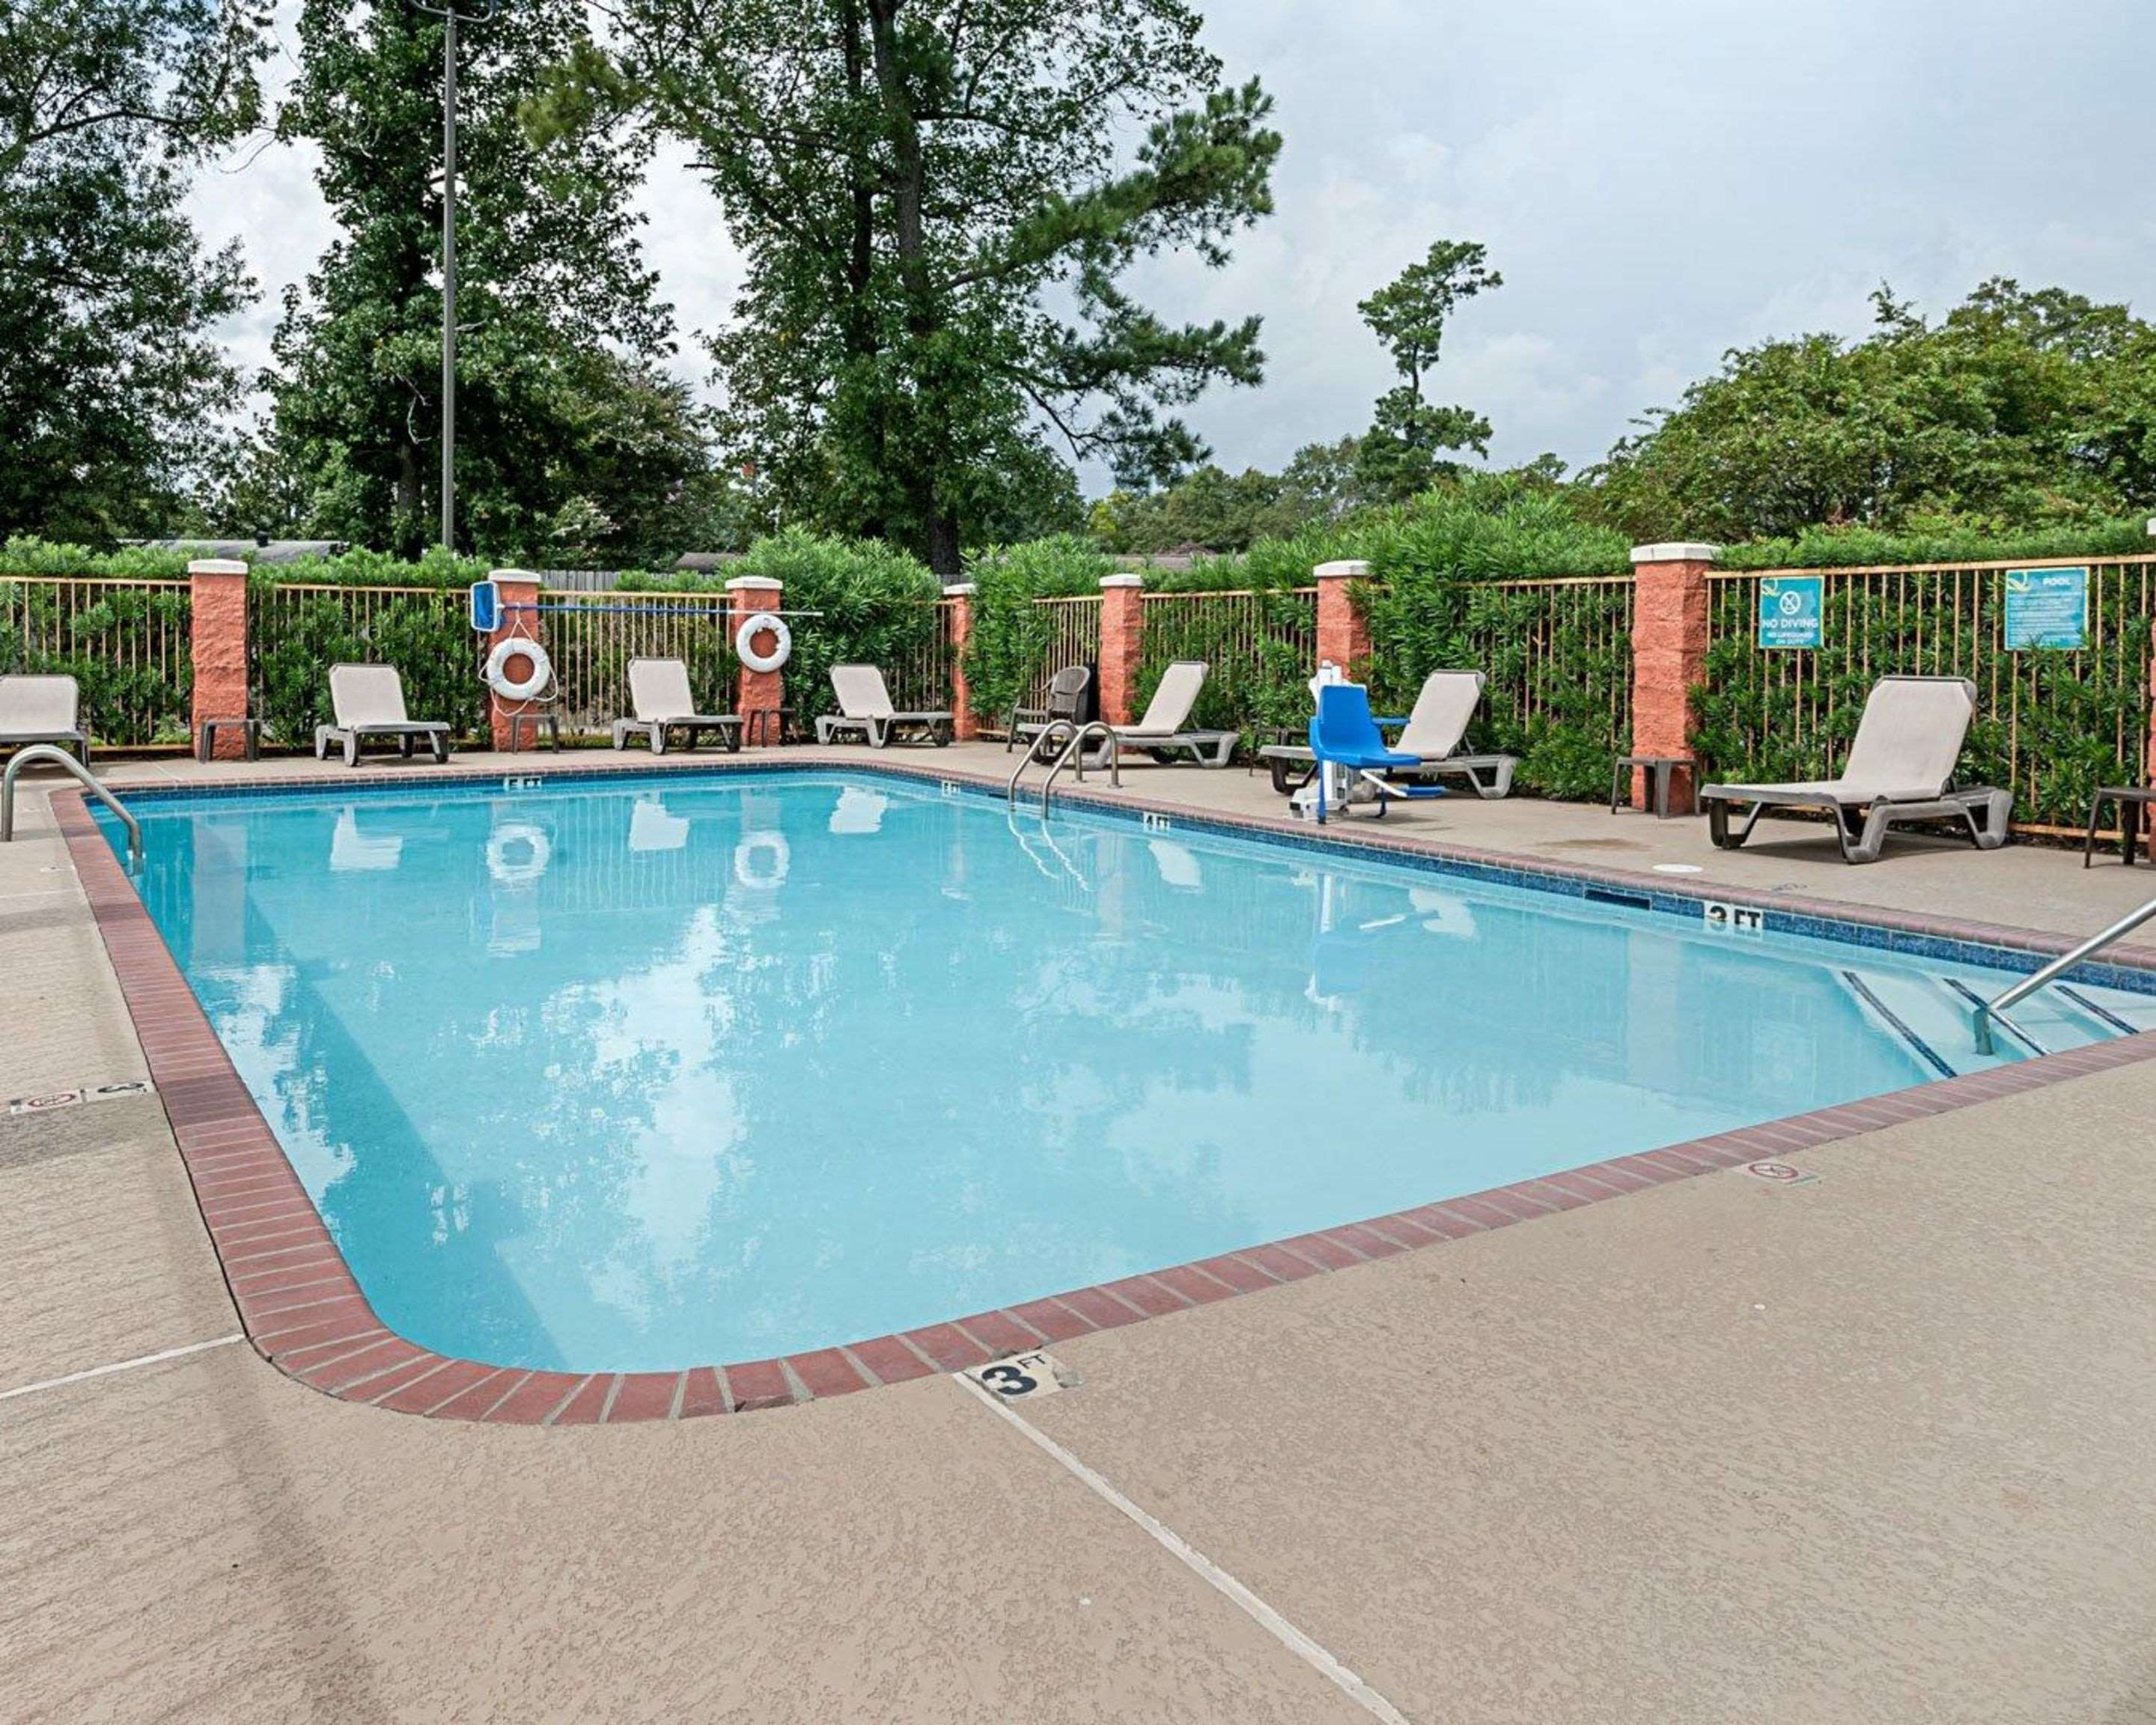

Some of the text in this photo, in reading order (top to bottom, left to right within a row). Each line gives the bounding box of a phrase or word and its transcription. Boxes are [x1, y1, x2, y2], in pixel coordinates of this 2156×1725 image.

[2042, 577, 2071, 585] POOL
[1762, 618, 1818, 628] NO DIVING
[1734, 908, 1761, 928] FT
[981, 1353, 1046, 1396] 3 FT
